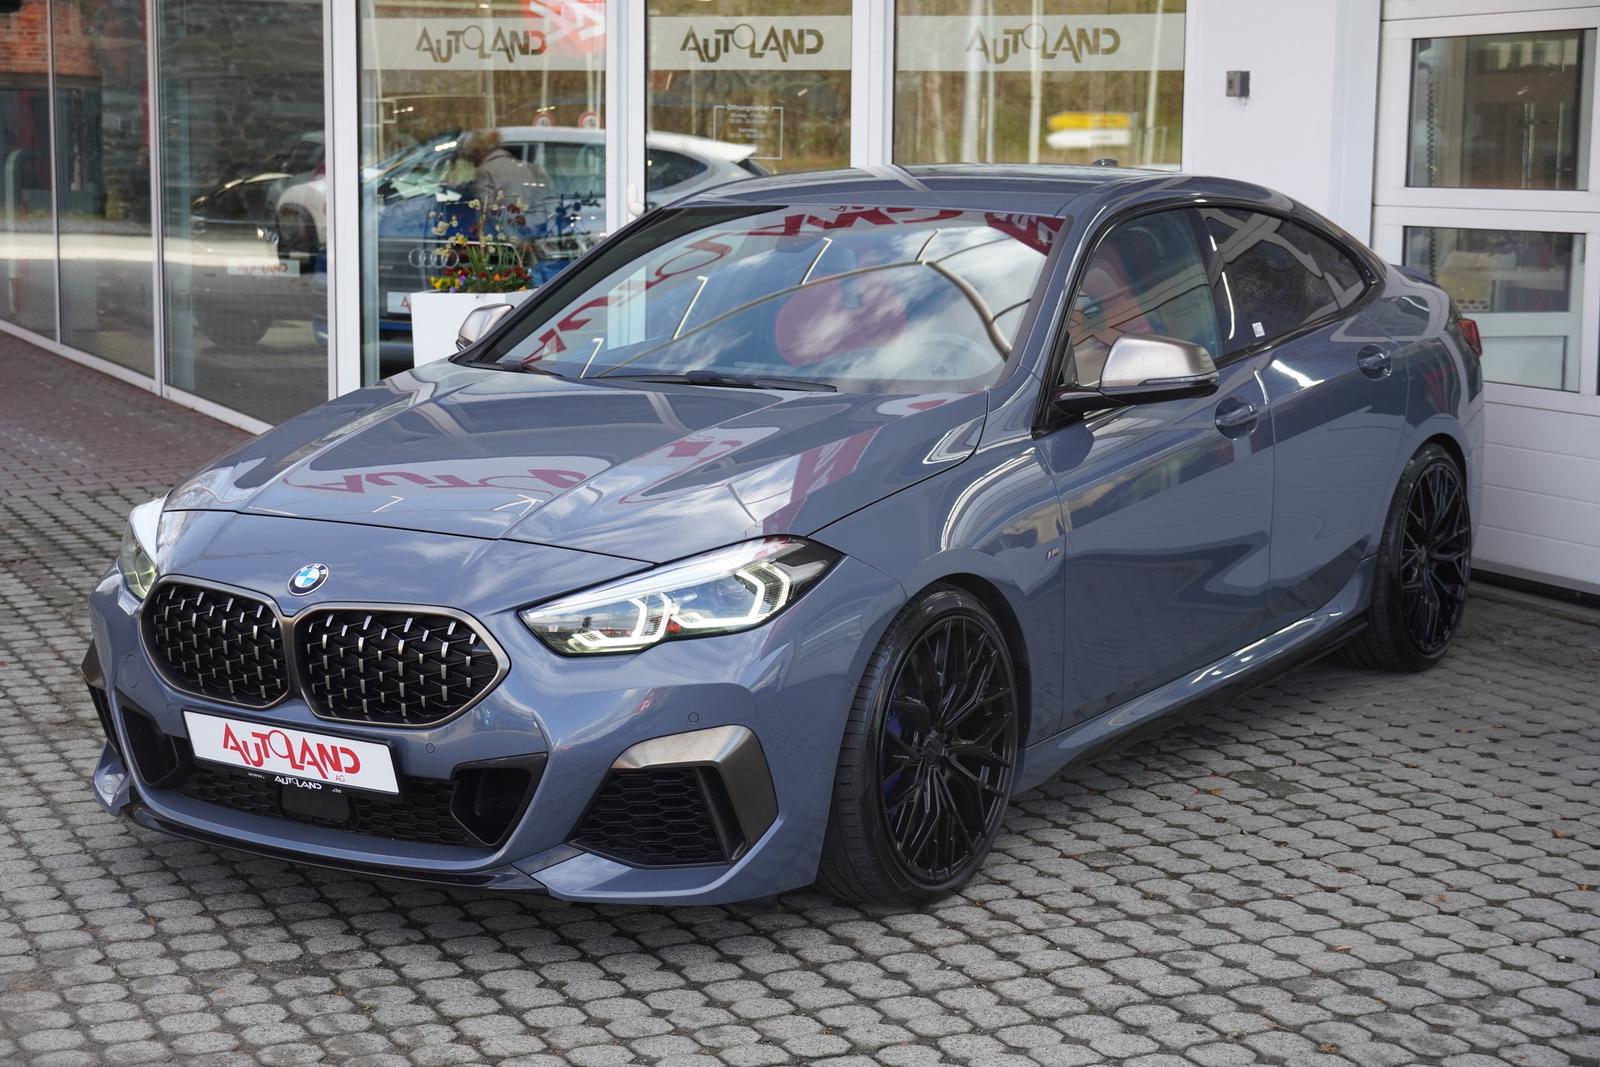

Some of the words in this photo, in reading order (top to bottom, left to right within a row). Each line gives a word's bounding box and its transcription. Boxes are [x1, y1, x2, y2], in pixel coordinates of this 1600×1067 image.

[415, 25, 547, 63] AUTOLAND
[680, 23, 824, 63] AUTOLAND
[966, 23, 1121, 64] AUTOLAND
[223, 722, 361, 779] AUTOLAND
